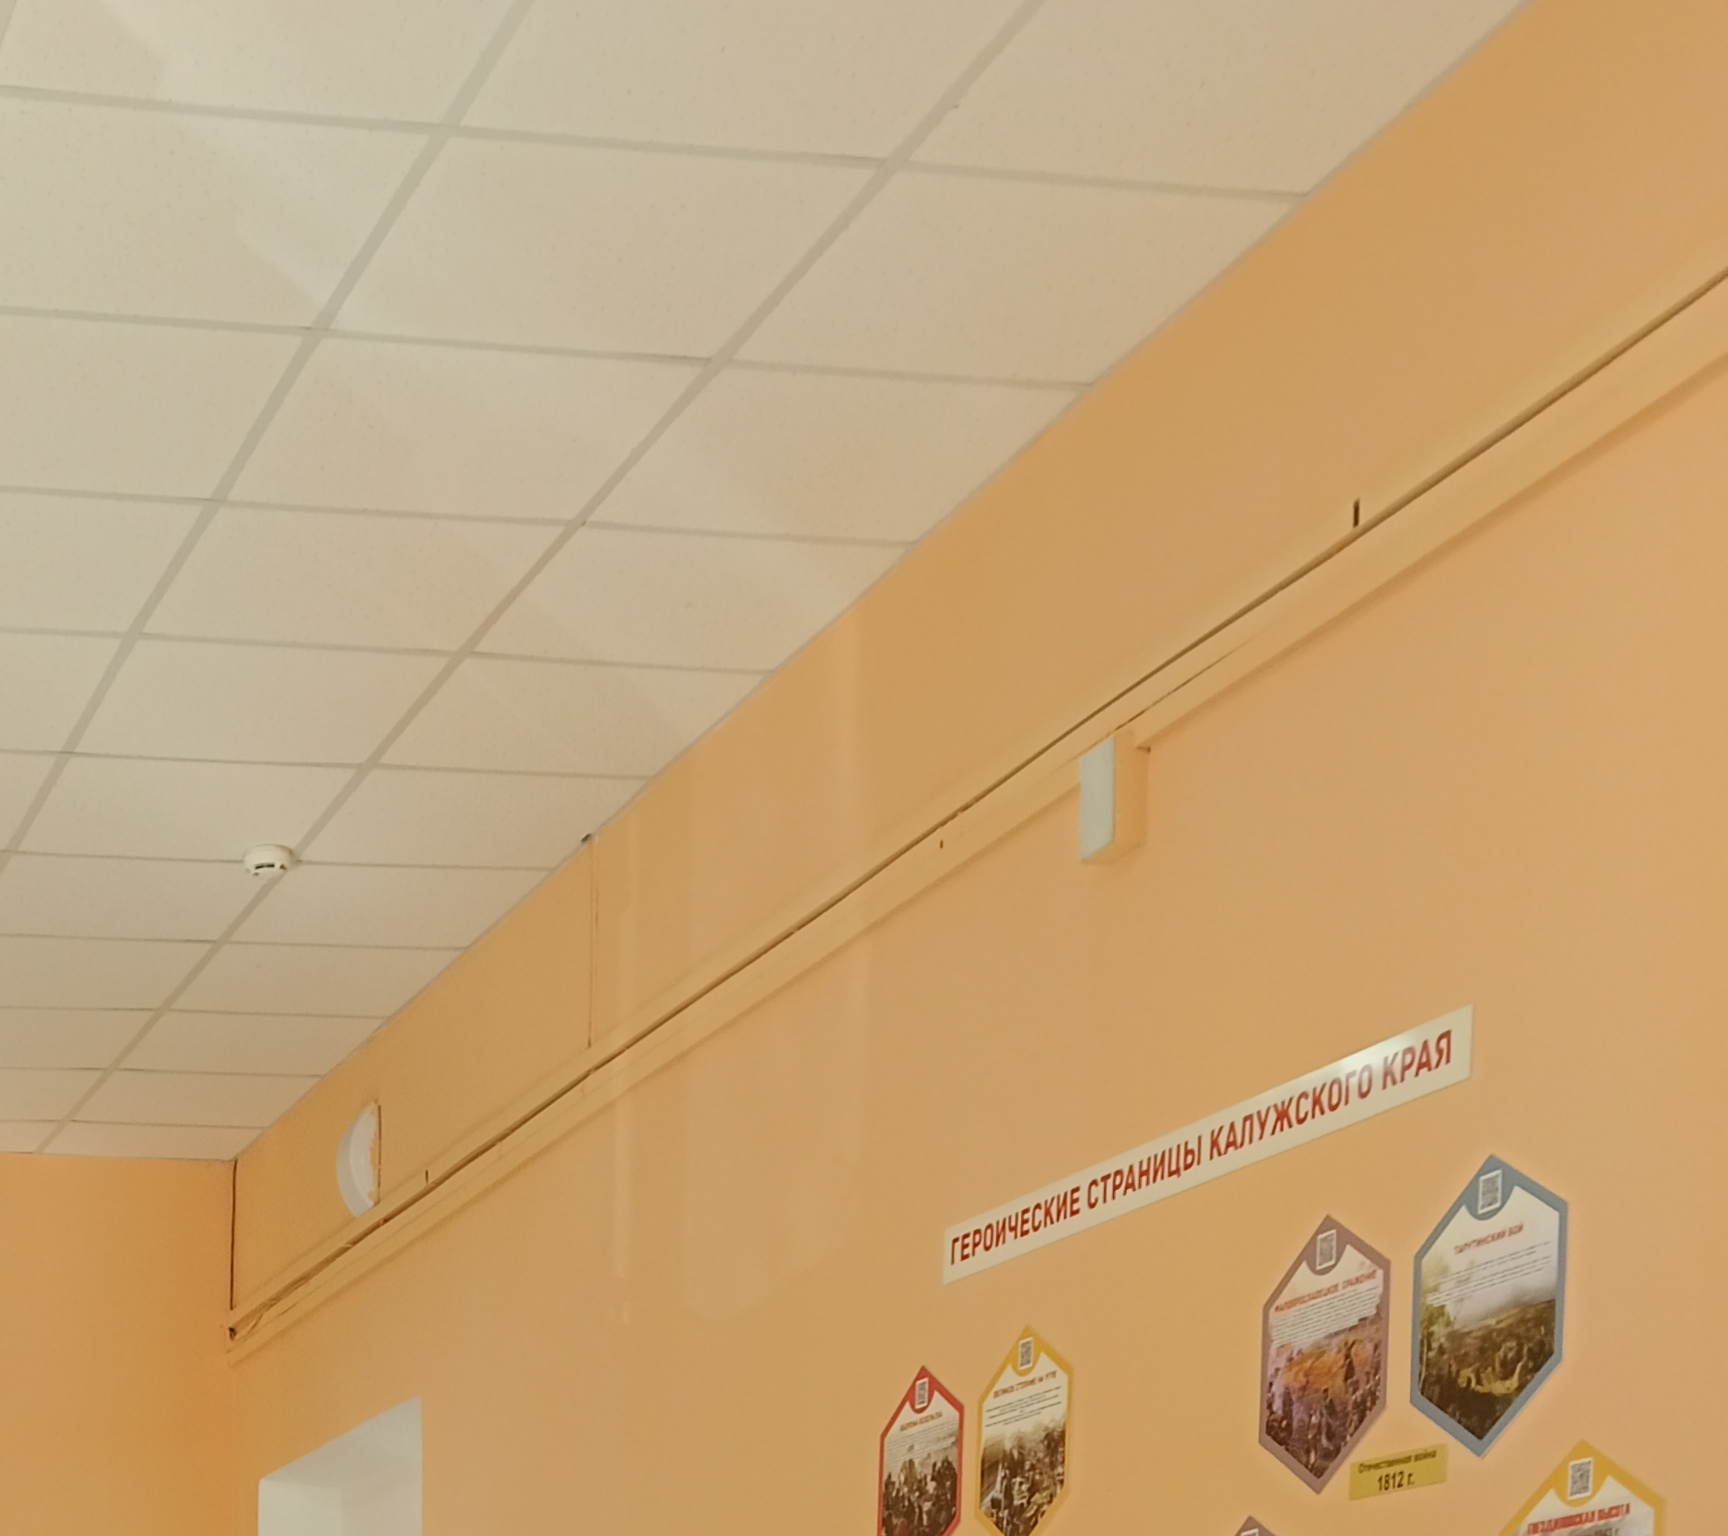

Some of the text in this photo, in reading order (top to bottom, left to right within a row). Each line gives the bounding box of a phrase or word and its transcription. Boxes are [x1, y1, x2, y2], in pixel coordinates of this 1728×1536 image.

[951, 1029, 1452, 1265] ГЕРОИЧЕСКИЕ СТРАНИЦЫ КАЛУЖСКОГО КРАЯ
[1377, 1471, 1404, 1492] 1812
